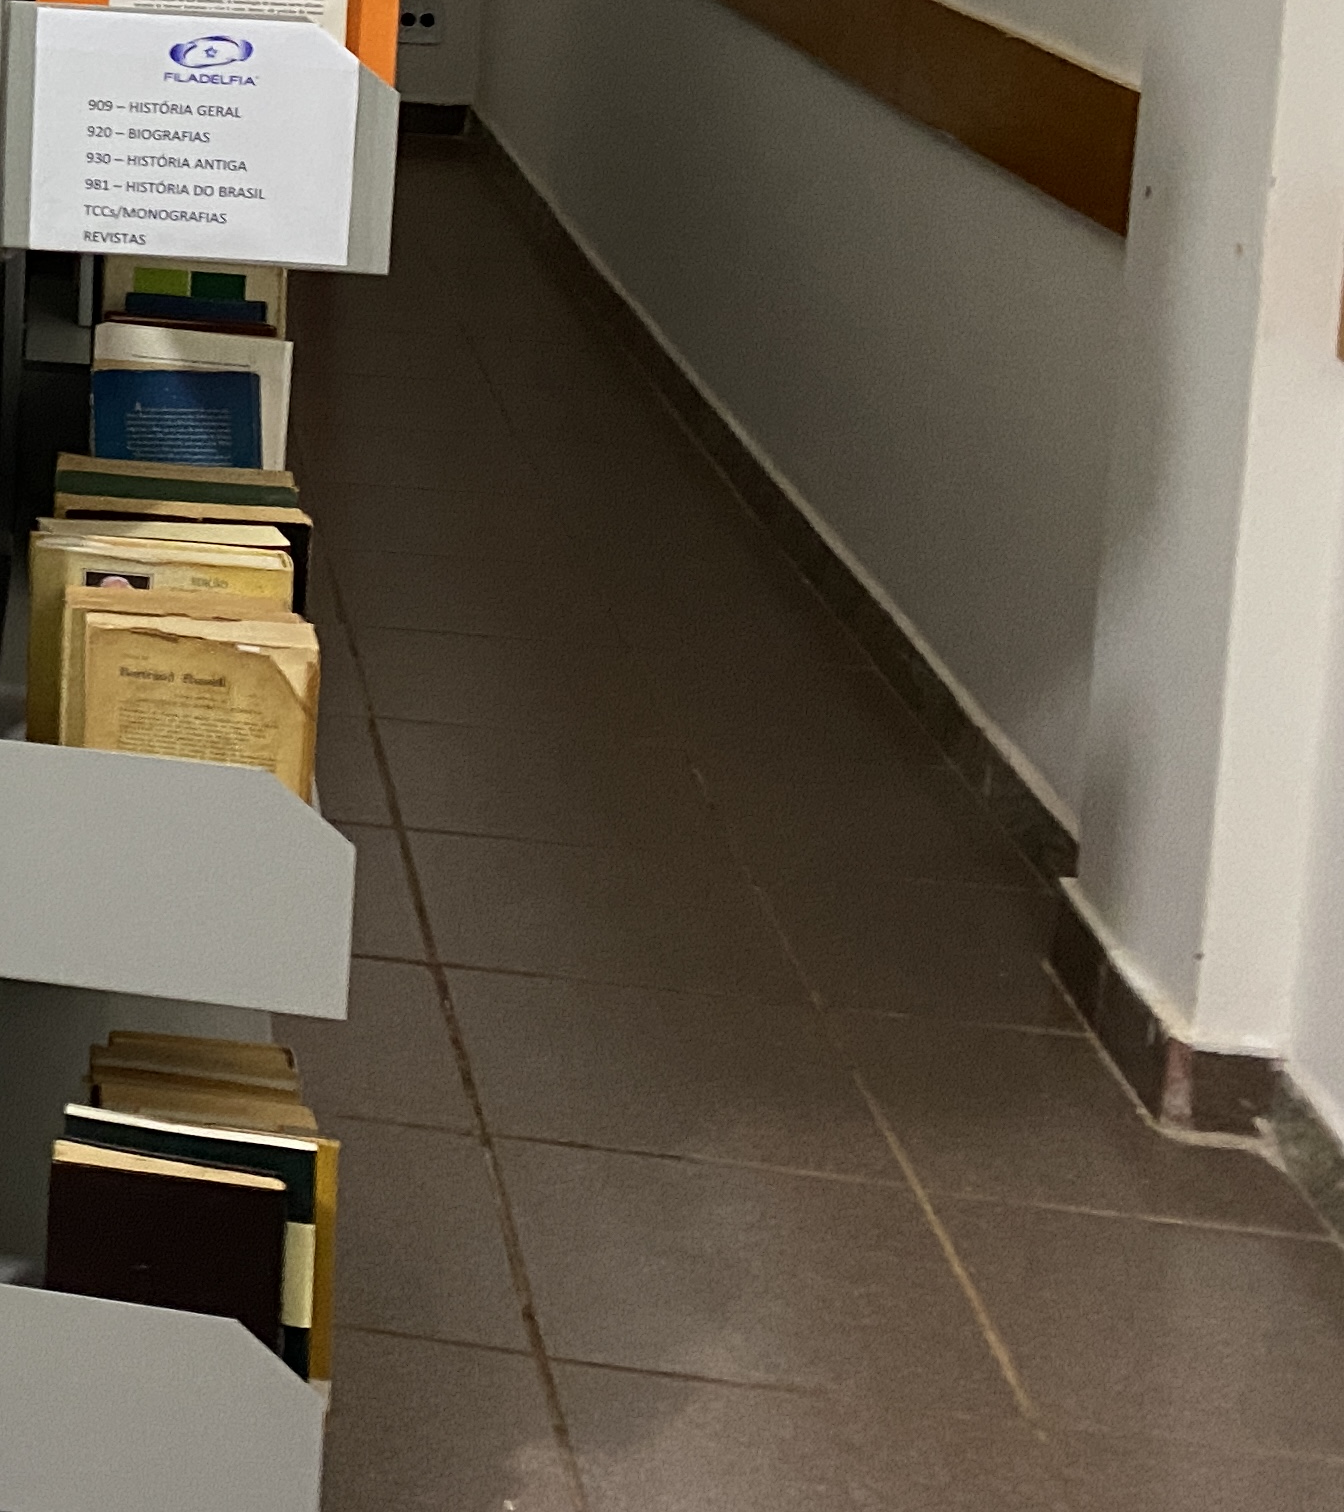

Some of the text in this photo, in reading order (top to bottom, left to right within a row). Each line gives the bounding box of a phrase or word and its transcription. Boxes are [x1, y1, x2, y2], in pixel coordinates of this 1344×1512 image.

[164, 73, 256, 86] FILADELFIA
[89, 100, 241, 118] 909 HISTÓRIA GERAL
[88, 126, 210, 143] 920 BIOGRAFIAS
[87, 153, 247, 171] 930 HISTÓRIA ANTIGA
[85, 179, 265, 199] 981 HISTÓRIA DO BRASIL
[84, 231, 146, 245] REVISTAS
